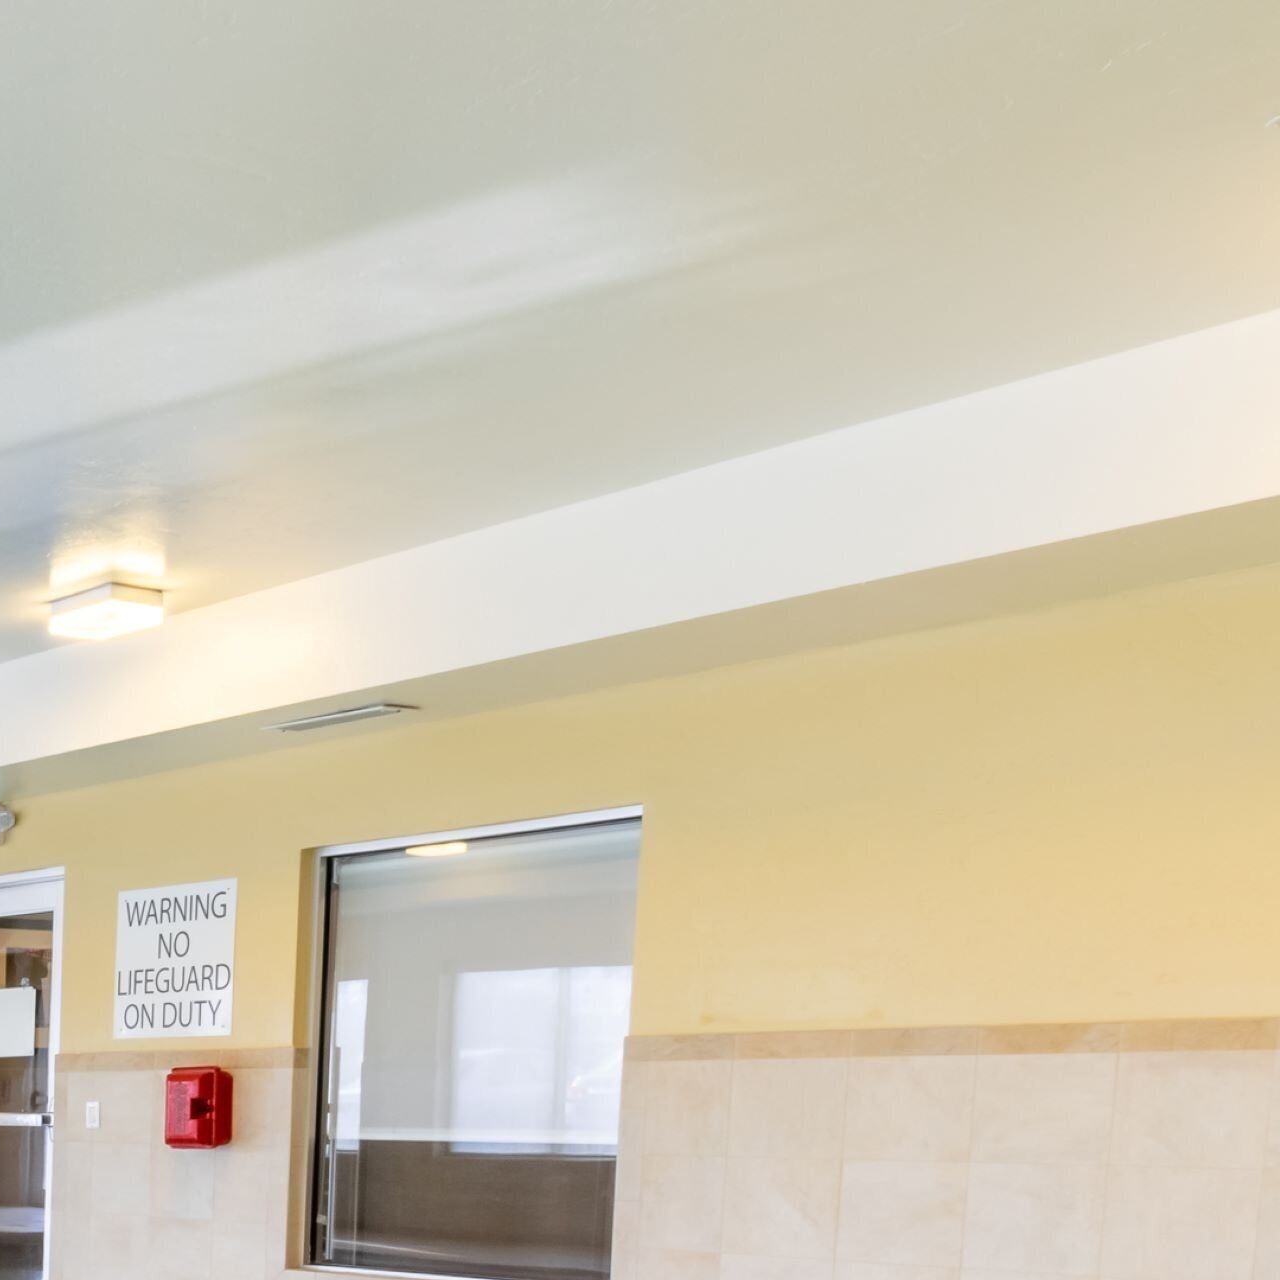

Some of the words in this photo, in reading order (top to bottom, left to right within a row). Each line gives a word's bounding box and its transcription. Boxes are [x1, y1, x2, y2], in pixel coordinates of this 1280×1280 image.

[125, 890, 228, 927] WARNING
[157, 931, 191, 959] NO
[117, 963, 232, 997] LIFEGUARD
[123, 1003, 155, 1030] ON
[162, 999, 223, 1029] DUTY
